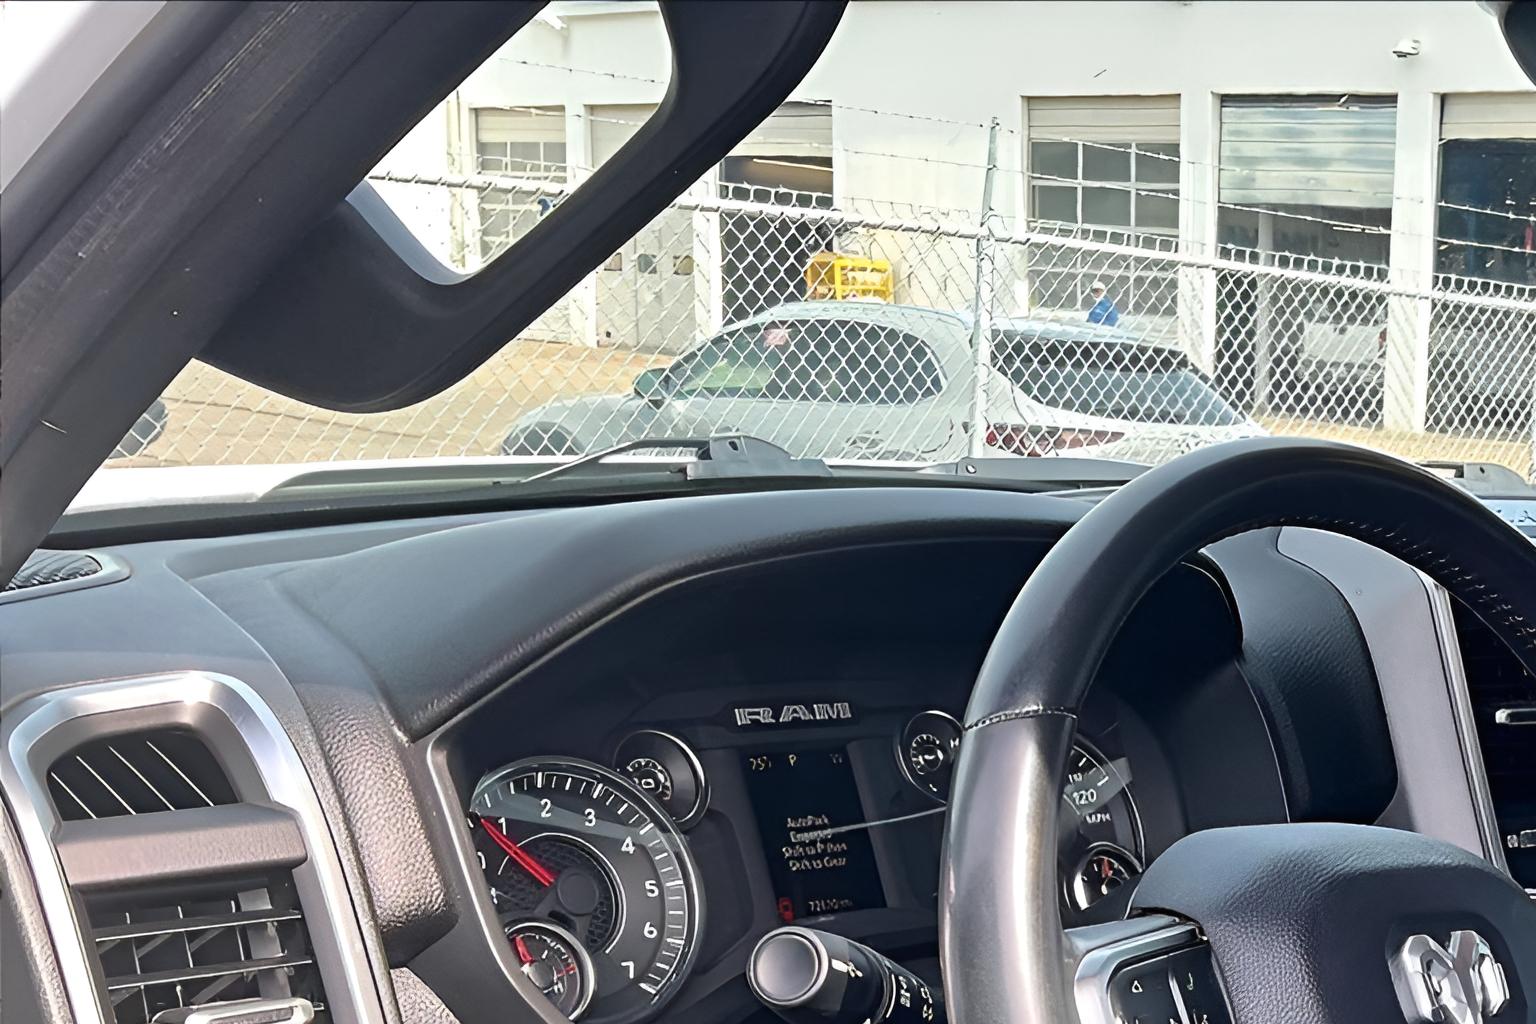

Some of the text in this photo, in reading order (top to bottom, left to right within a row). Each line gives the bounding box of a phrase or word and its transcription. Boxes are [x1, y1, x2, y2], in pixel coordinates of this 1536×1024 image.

[735, 702, 852, 726] RAM
[1072, 788, 1097, 805] 120
[539, 798, 553, 819] 2
[583, 808, 597, 828] 3
[497, 816, 508, 836] 1
[620, 836, 636, 855] 4
[644, 879, 660, 898] 5
[643, 921, 658, 939] 6
[620, 960, 635, 979] 7
